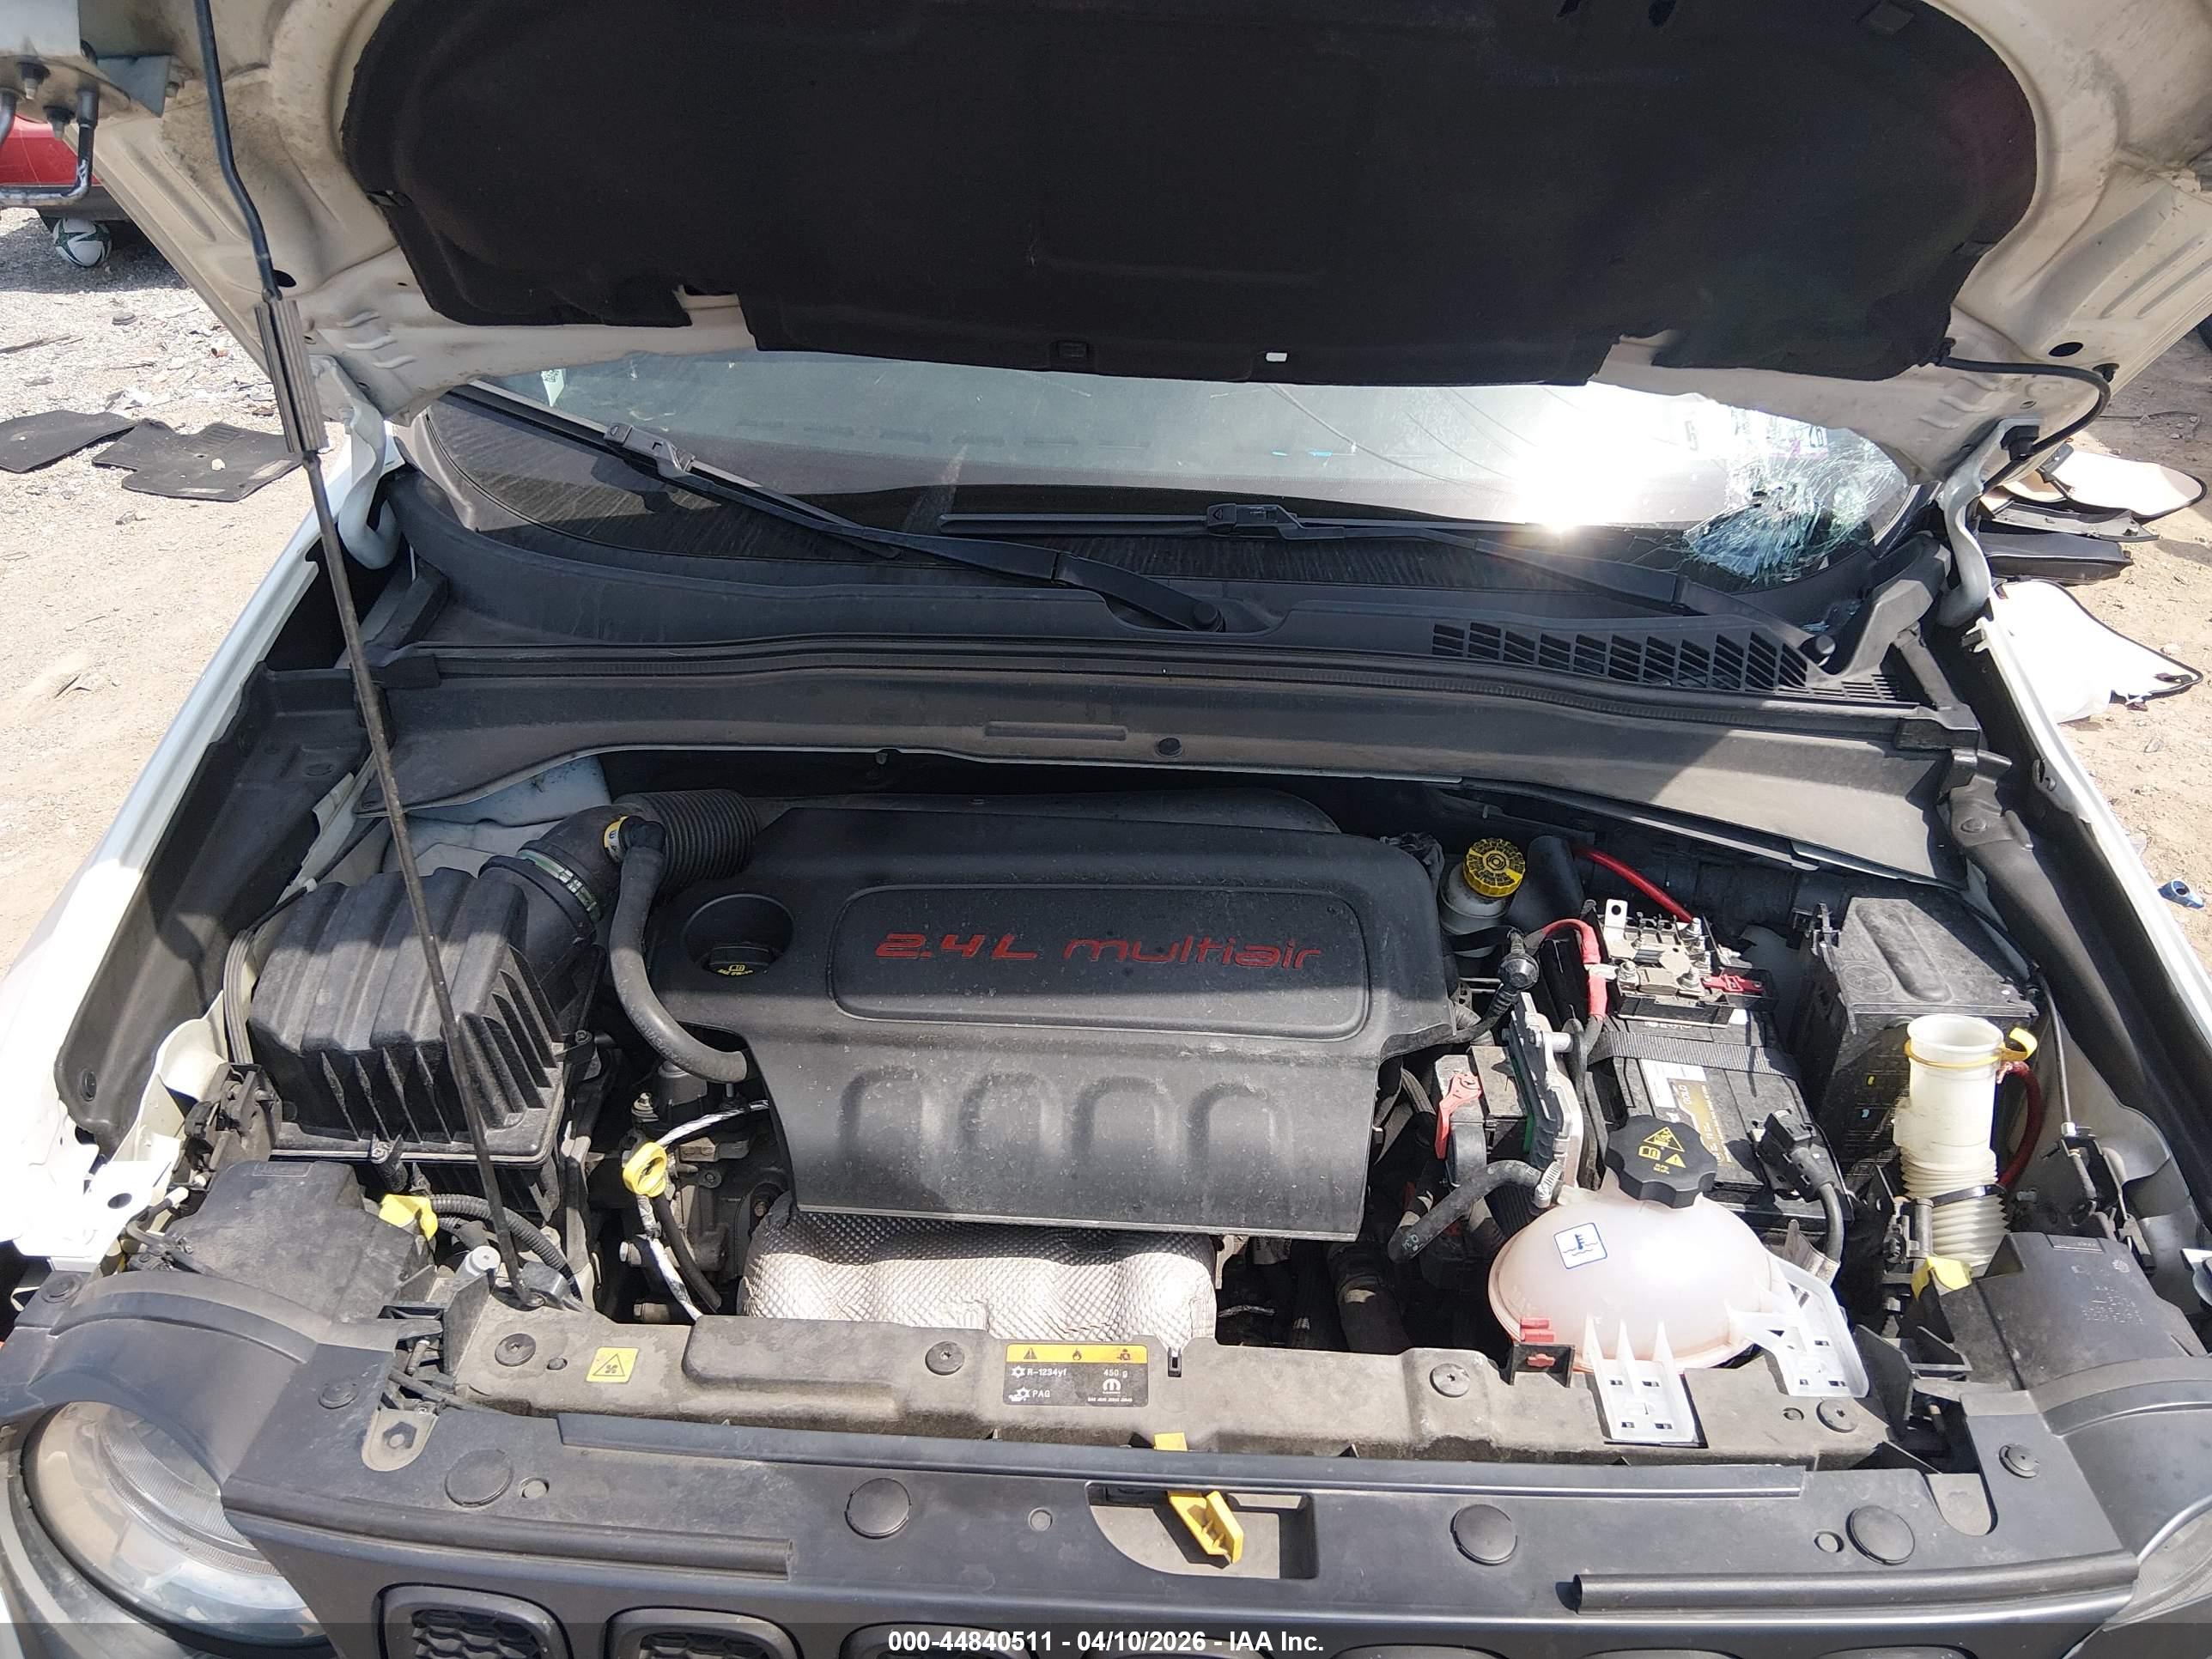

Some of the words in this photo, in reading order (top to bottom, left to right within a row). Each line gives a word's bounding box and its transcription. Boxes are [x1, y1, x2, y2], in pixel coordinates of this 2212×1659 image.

[1062, 935, 1322, 969] multiair
[1026, 1368, 1067, 1378] R-1234yf
[1032, 1389, 1050, 1398] PAG
